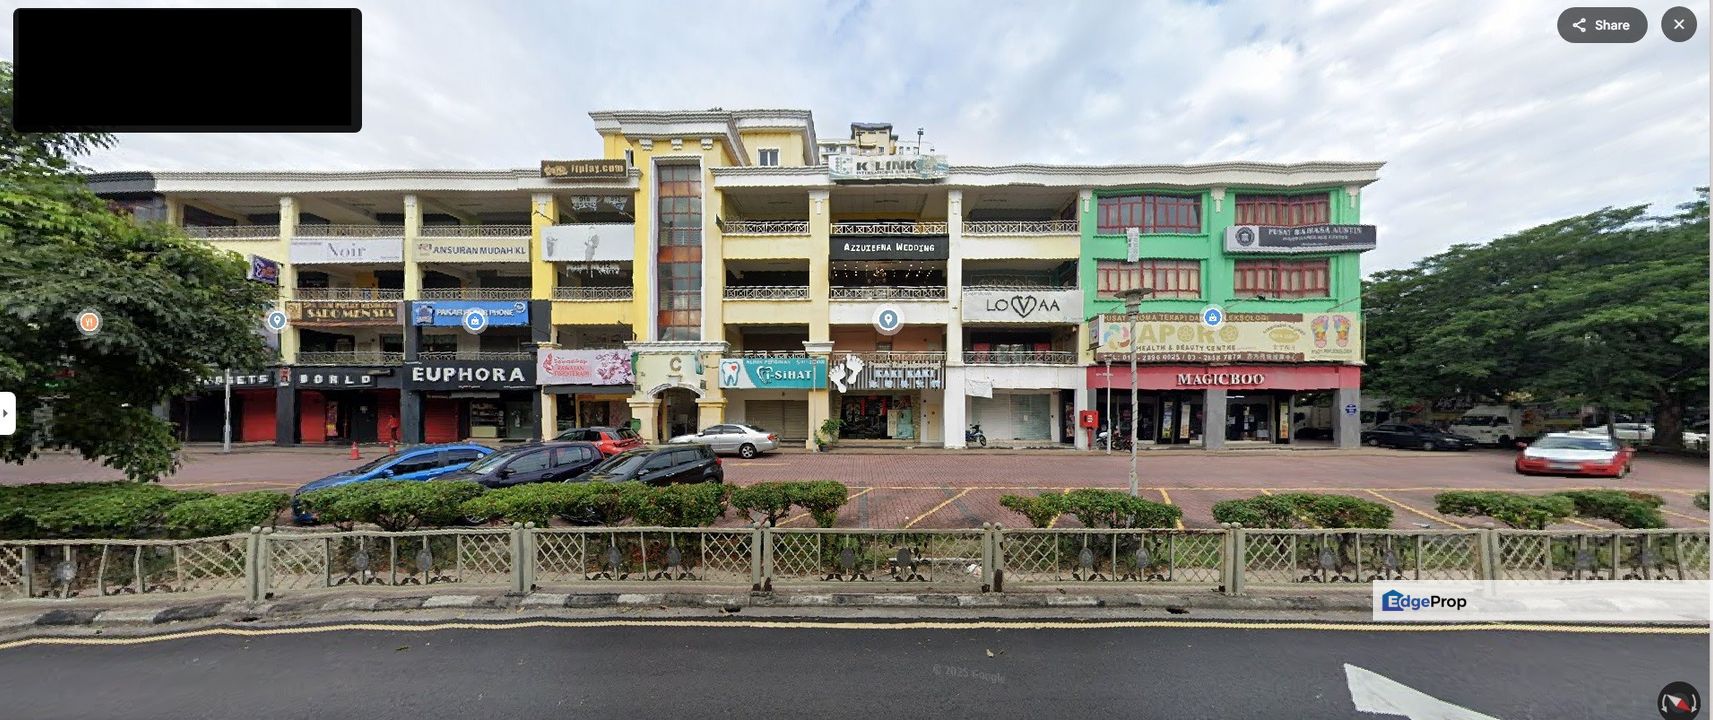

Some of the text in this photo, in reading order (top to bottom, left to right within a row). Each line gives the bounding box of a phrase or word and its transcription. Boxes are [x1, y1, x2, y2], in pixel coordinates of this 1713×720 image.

[856, 160, 917, 170] K LINK
[433, 246, 527, 255] ANSURAN MUDAH KL
[412, 366, 526, 382] EUPHORA
